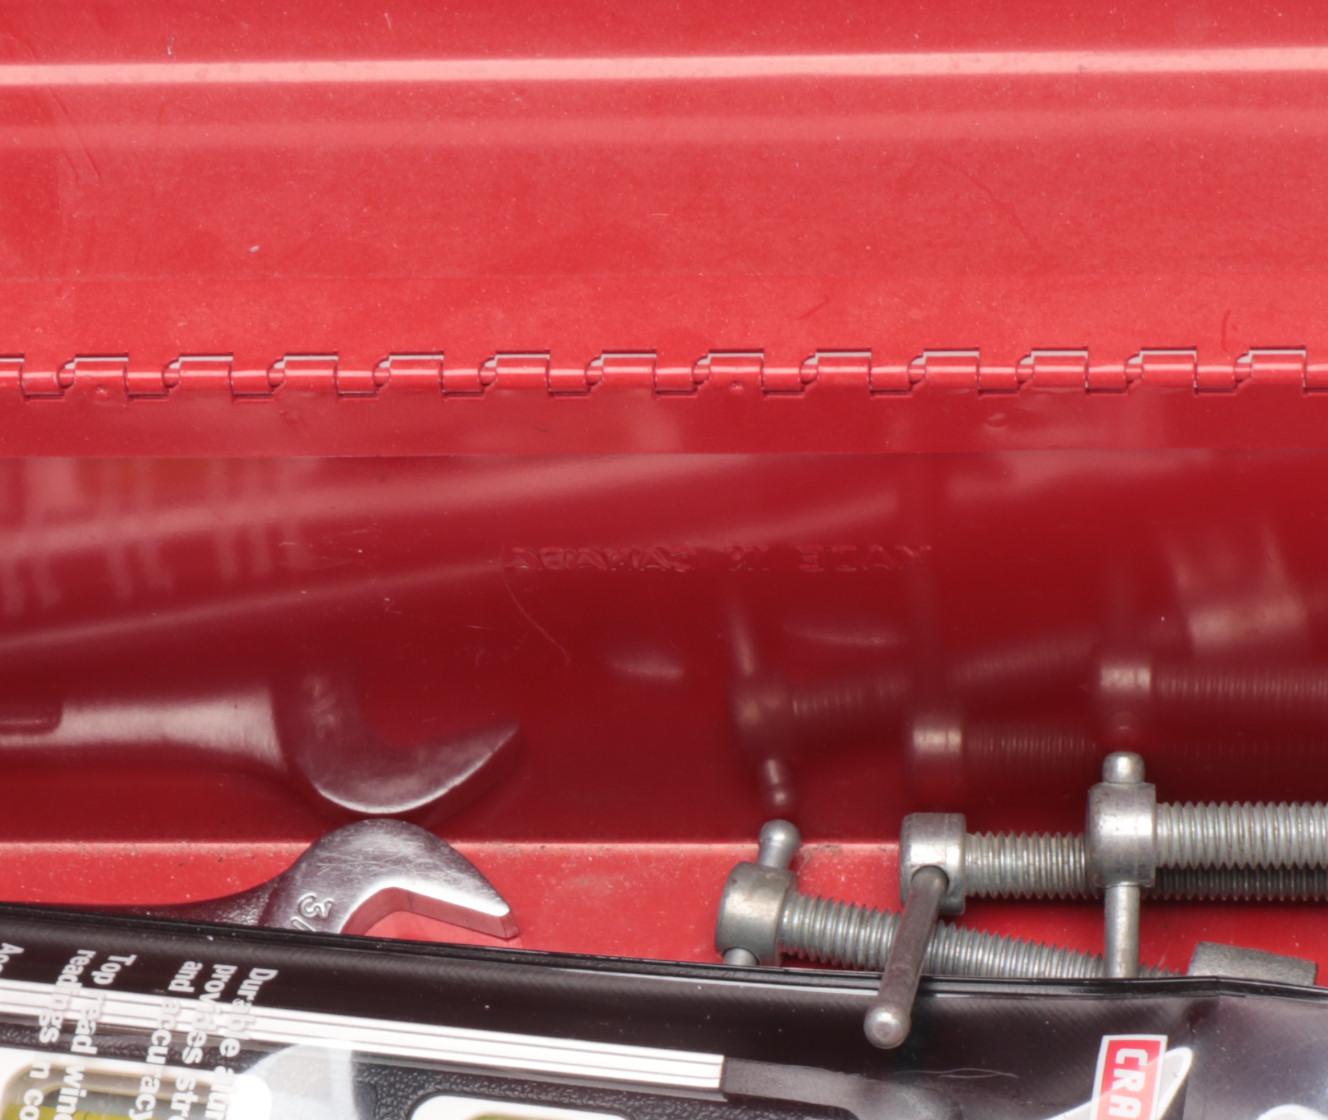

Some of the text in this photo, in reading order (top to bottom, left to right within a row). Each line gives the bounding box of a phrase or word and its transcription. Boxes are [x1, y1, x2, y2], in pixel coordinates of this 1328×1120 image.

[92, 954, 137, 985] Top
[168, 960, 202, 993] and
[70, 993, 106, 1054] read
[182, 964, 237, 1064] provides
[220, 968, 278, 1057] Durable
